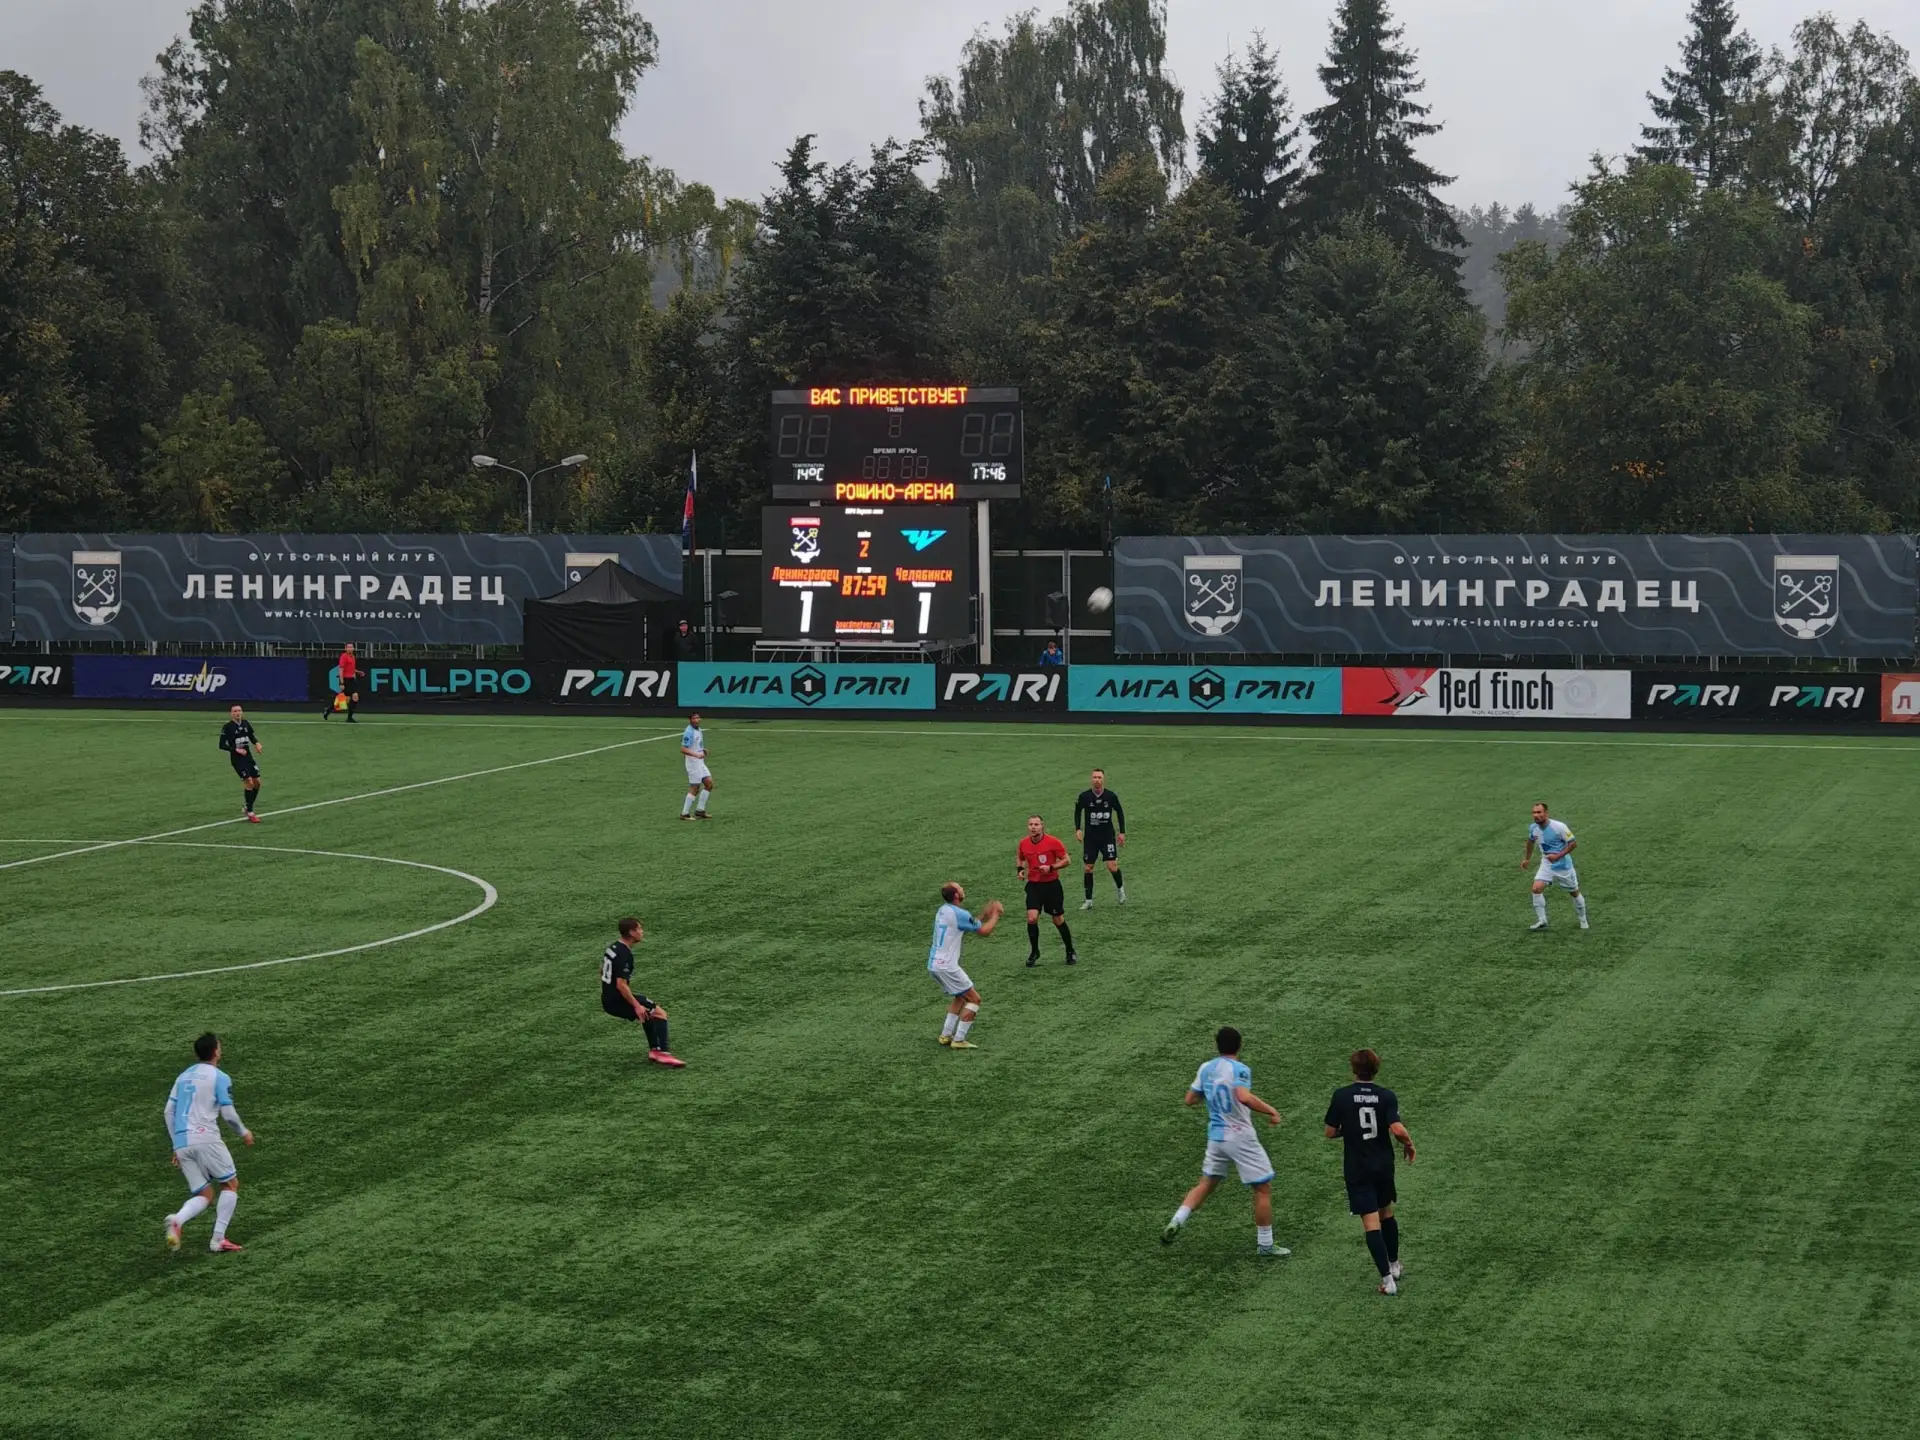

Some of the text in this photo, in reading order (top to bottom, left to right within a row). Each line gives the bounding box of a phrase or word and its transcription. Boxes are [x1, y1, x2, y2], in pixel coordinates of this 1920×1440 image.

[811, 387, 968, 405] ВАС ПРИВЕТСТВУЕТ
[974, 467, 1006, 480] 17:46
[836, 483, 955, 500] РОЩИНО-АРЕНА
[249, 552, 436, 562] ФУТБОЛЬНЫЙ КЛУБ
[859, 540, 870, 557] 2
[1394, 554, 1617, 565] ФУТБОЛЬНЫЙ КЛУБ
[182, 574, 505, 605] ЛЕНИНГРАДЕЦ
[841, 575, 887, 596] 87:59
[1314, 579, 1700, 612] ЛЕНИНГРАДЕЦ
[265, 609, 421, 619] www.fc-leningradec.ru
[800, 591, 813, 633] 1
[918, 592, 932, 634] 1
[1412, 617, 1599, 628] www.fc-leningradec.ru
[370, 668, 532, 694] FNL.PRO
[560, 669, 671, 698] PARI
[704, 675, 784, 694] ЛИГА
[834, 676, 911, 696] PARI
[944, 673, 1060, 702] PARI
[1096, 679, 1180, 699] ЛИГА
[1234, 681, 1315, 700] PARI
[1439, 670, 1554, 715] Red finch
[1647, 684, 1740, 706] PARI
[1769, 685, 1865, 709] PARI
[1358, 1106, 1378, 1140] 9
